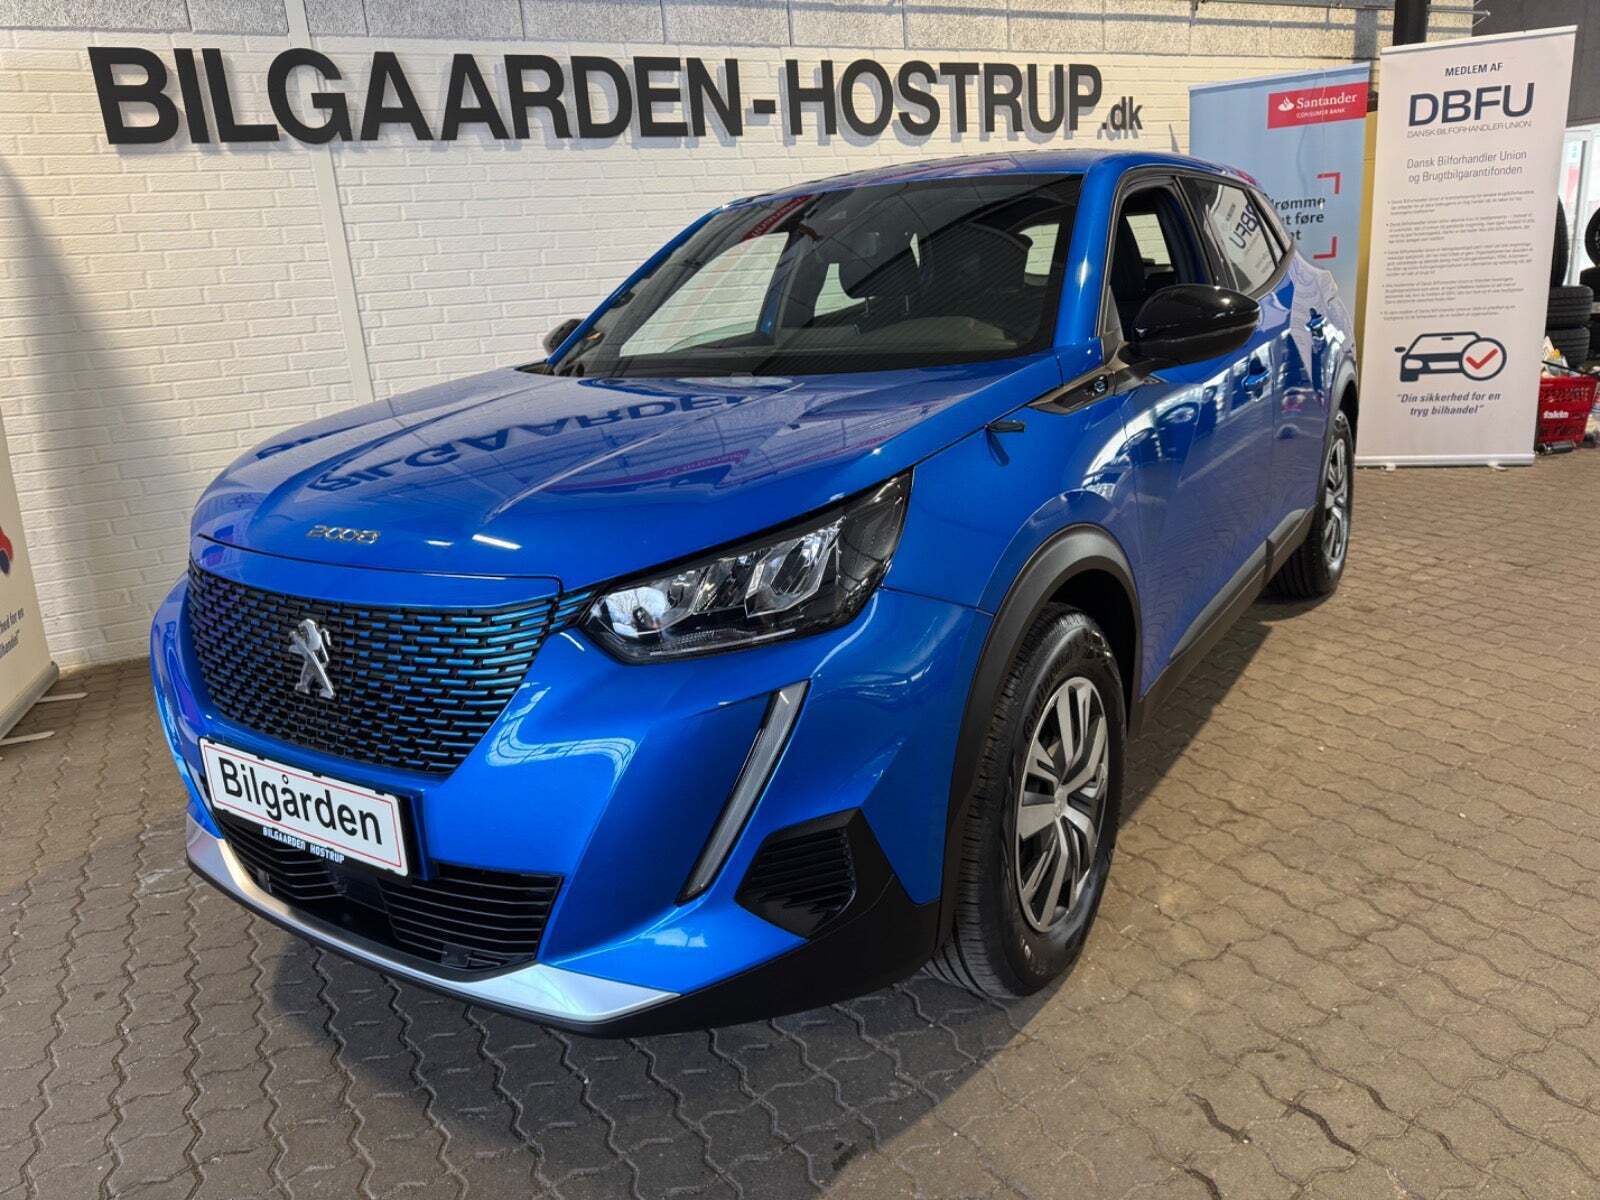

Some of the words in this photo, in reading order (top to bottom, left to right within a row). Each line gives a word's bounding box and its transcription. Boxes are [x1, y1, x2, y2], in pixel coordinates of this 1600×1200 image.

[1445, 64, 1488, 77] MEDLEM
[1490, 62, 1504, 73] AF
[1296, 92, 1358, 110] Santander
[1408, 83, 1535, 127] DBFU
[1407, 129, 1437, 139] DANSK
[1504, 120, 1533, 130] UNION
[1406, 157, 1436, 169] Dansk
[1437, 152, 1497, 167] Bilforhandler
[1499, 150, 1528, 161] Union
[1408, 173, 1420, 184] og
[1422, 165, 1524, 183] Brugtbilgarantifonden
[1295, 211, 1325, 224] føre
[1420, 392, 1470, 402] sikkerhed
[1471, 391, 1486, 401] for
[1488, 392, 1501, 401] en
[1409, 407, 1429, 417] tryg
[305, 524, 381, 545] 2008
[218, 756, 383, 845] Bilgården
[263, 827, 306, 851] BILGAARDEN
[310, 844, 345, 864] HOSTRUP
